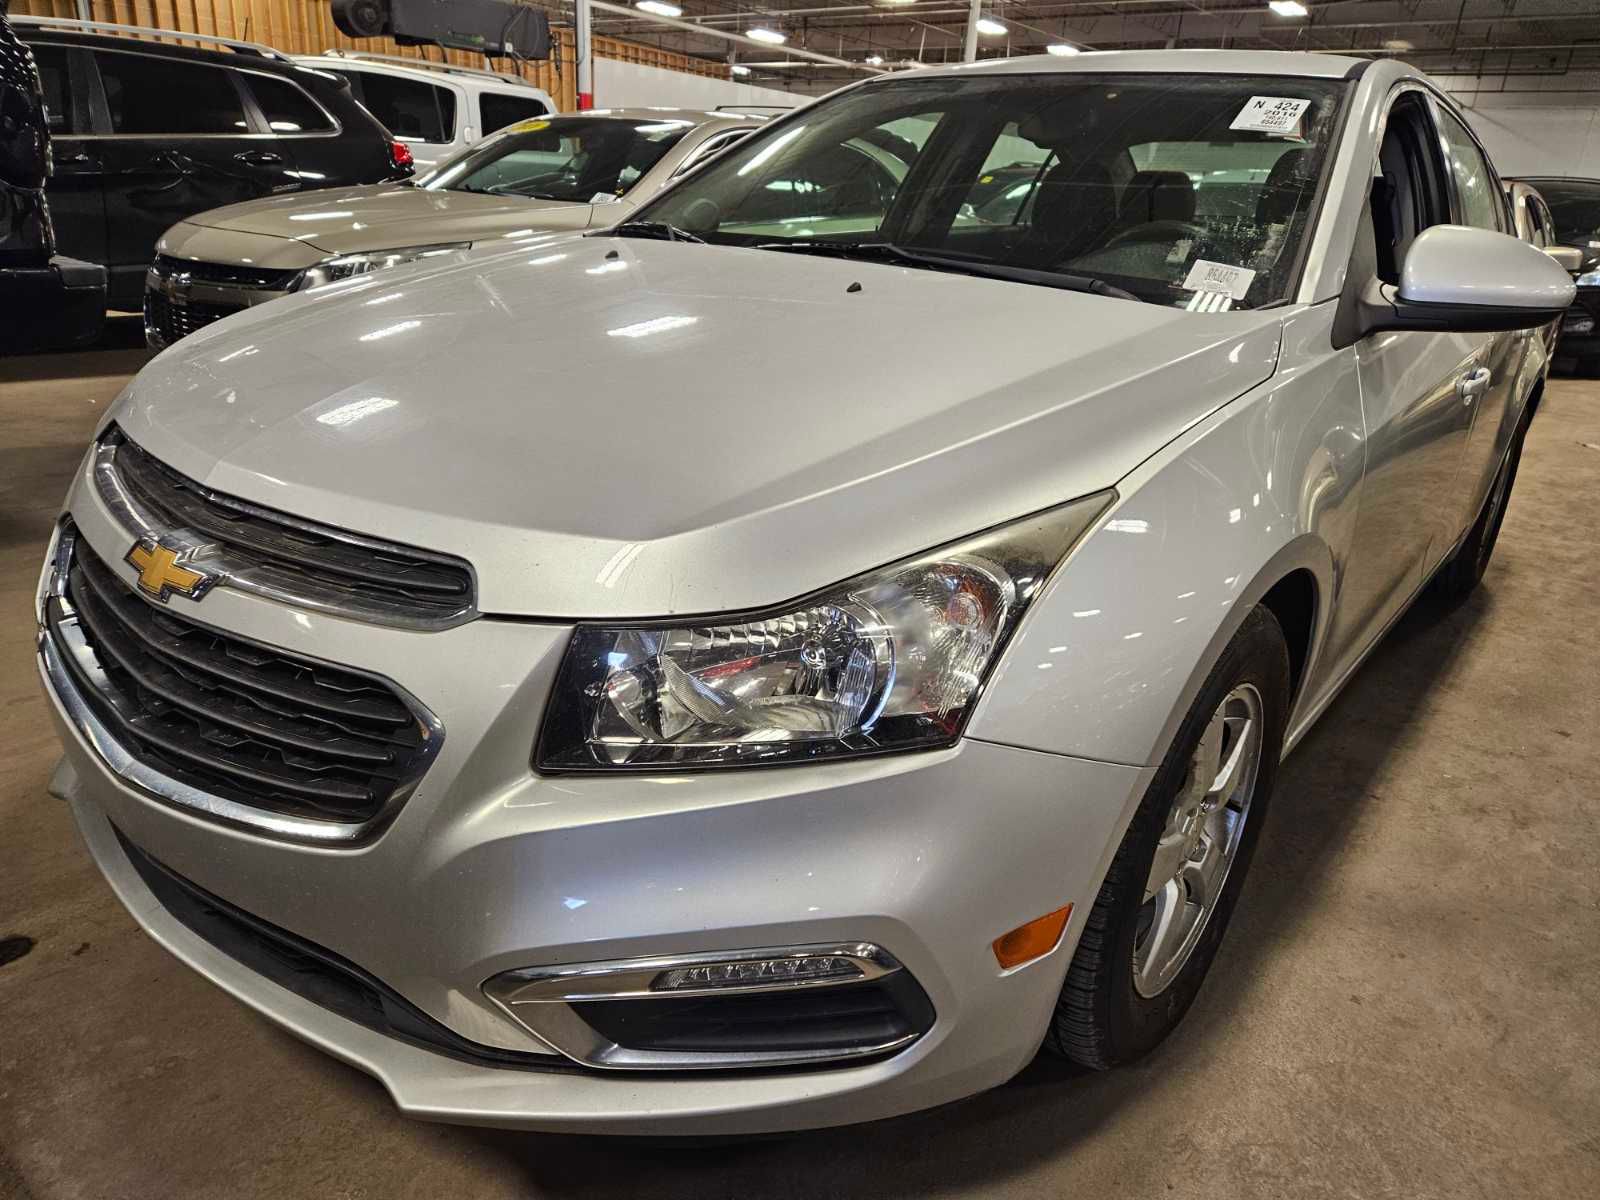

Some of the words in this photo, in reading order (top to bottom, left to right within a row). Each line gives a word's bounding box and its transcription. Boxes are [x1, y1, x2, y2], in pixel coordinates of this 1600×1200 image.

[1253, 100, 1266, 109] N
[1274, 102, 1301, 111] 424
[1264, 109, 1297, 117] 2016
